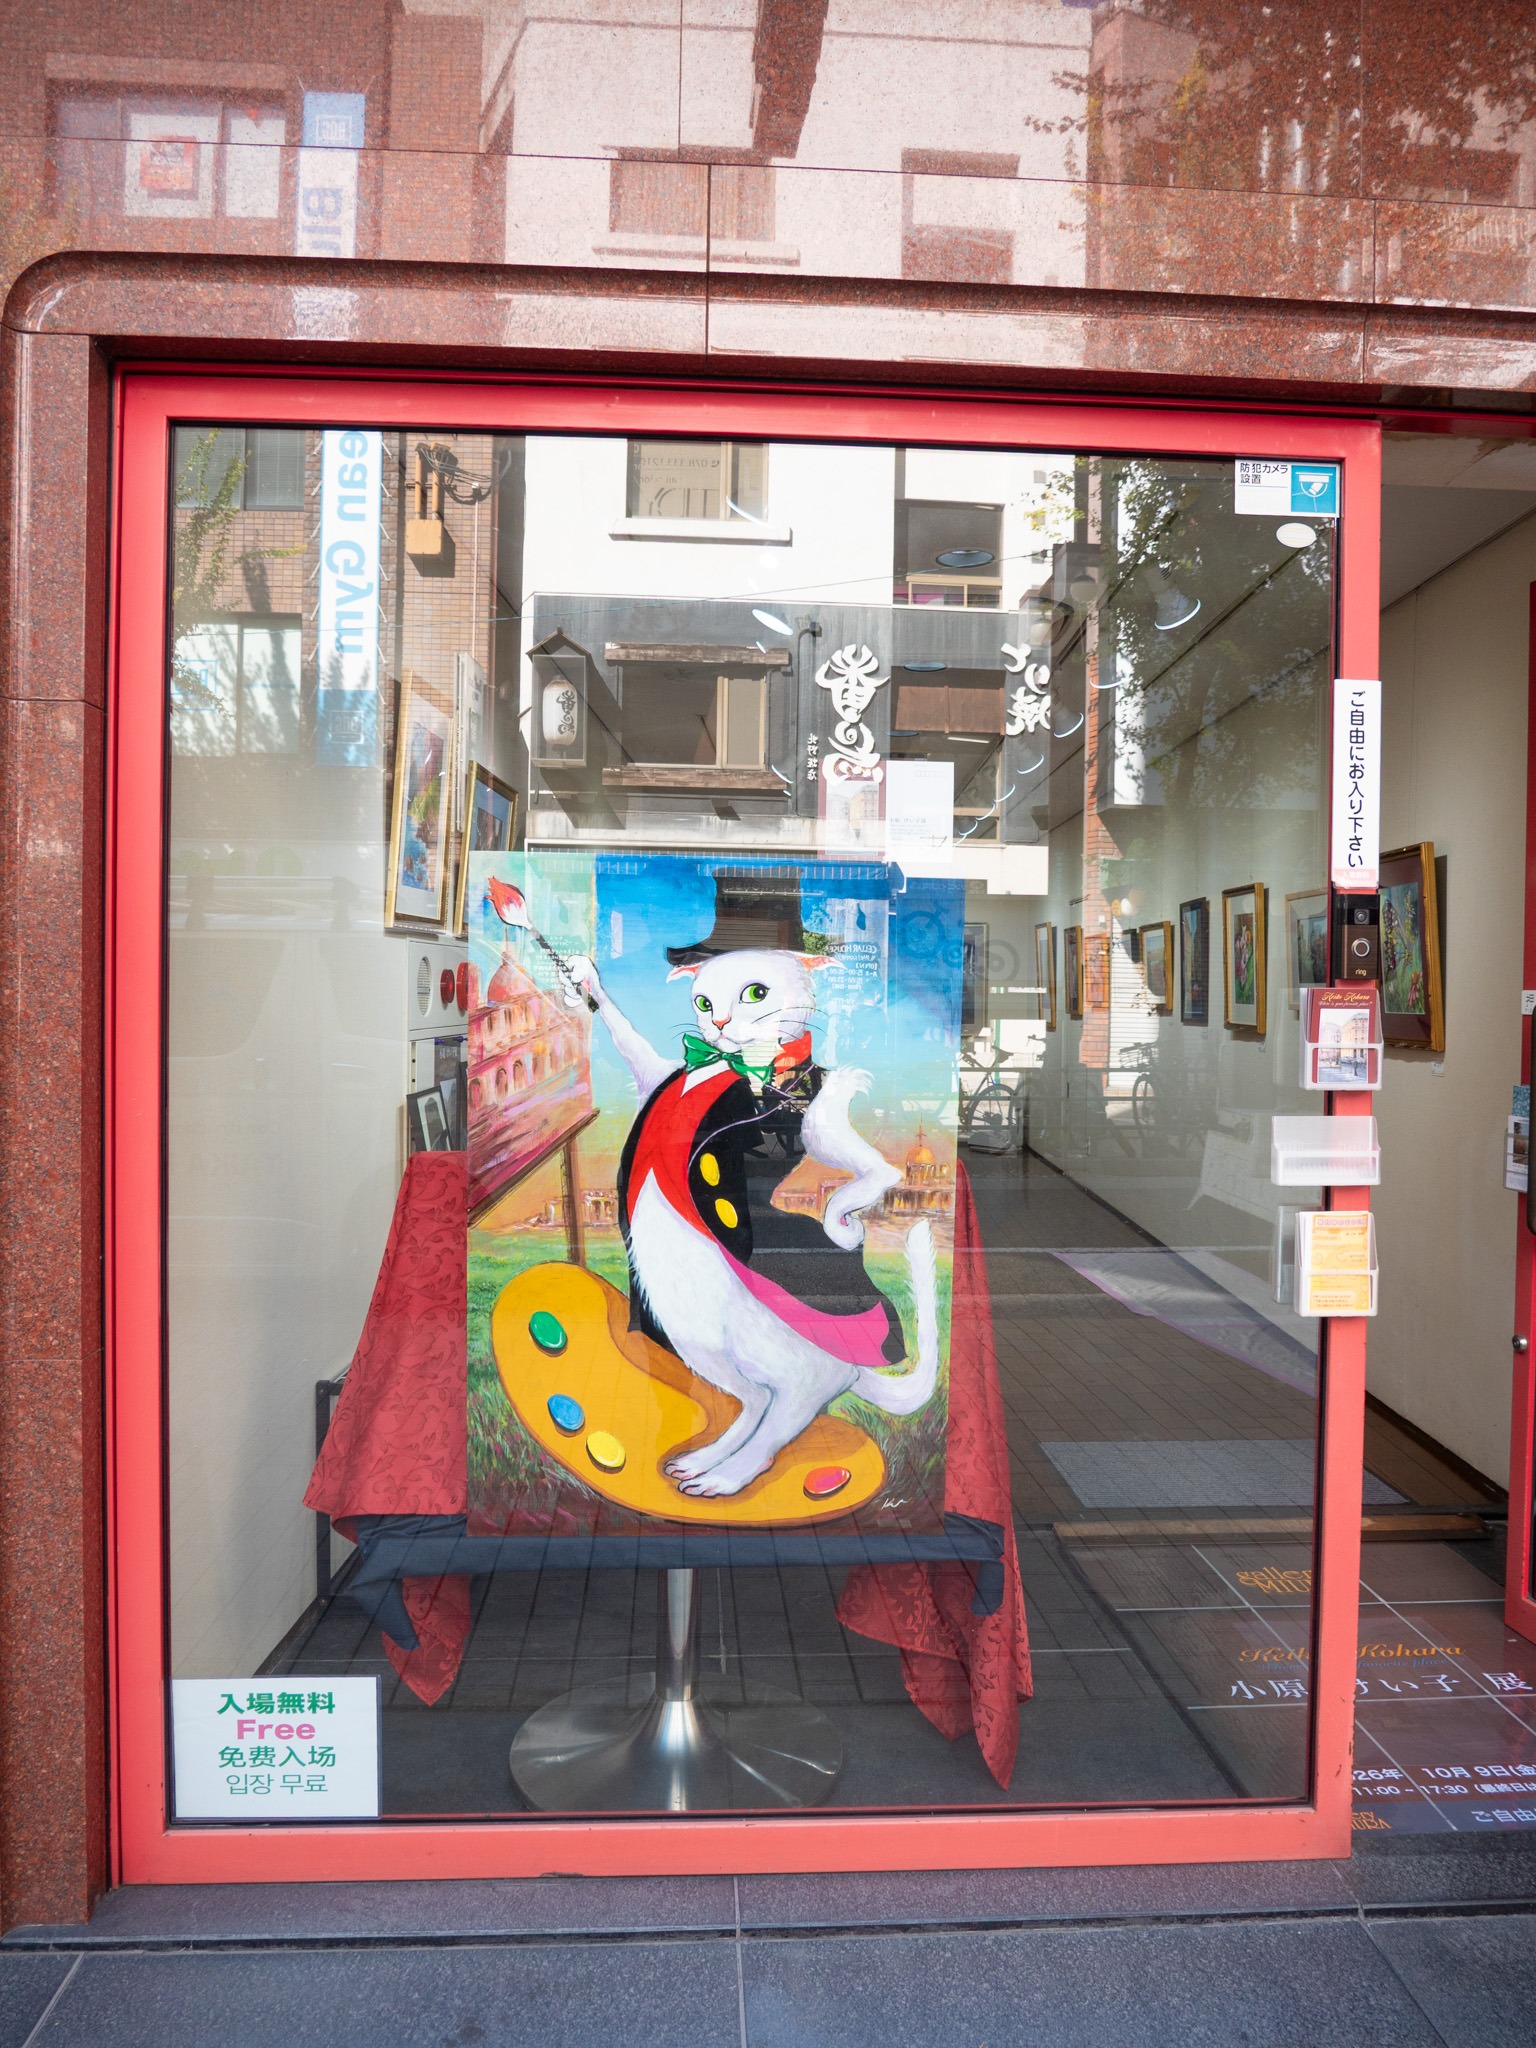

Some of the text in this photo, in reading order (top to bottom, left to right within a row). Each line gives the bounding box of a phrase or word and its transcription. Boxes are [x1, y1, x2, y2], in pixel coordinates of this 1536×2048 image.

[1240, 463, 1289, 474] 防犯カメラ
[1240, 474, 1261, 484] 設置
[1347, 690, 1365, 868] ご自由にお入り下さい
[1355, 968, 1367, 977] ring
[1321, 991, 1370, 1002] Keiko Kohara
[1236, 1566, 1312, 1586] galler
[1256, 1579, 1312, 1593] MIU
[1483, 1672, 1534, 1692] 展
[216, 1692, 336, 1715] 入場無料
[237, 1719, 316, 1740] Free
[218, 1746, 336, 1768] 免费入场
[1353, 1763, 1536, 1781] 26年 10月 9日(金
[226, 1773, 328, 1795] 입장 무료
[1419, 1785, 1469, 1795] 17:30
[1471, 1808, 1536, 1823] ご自由
